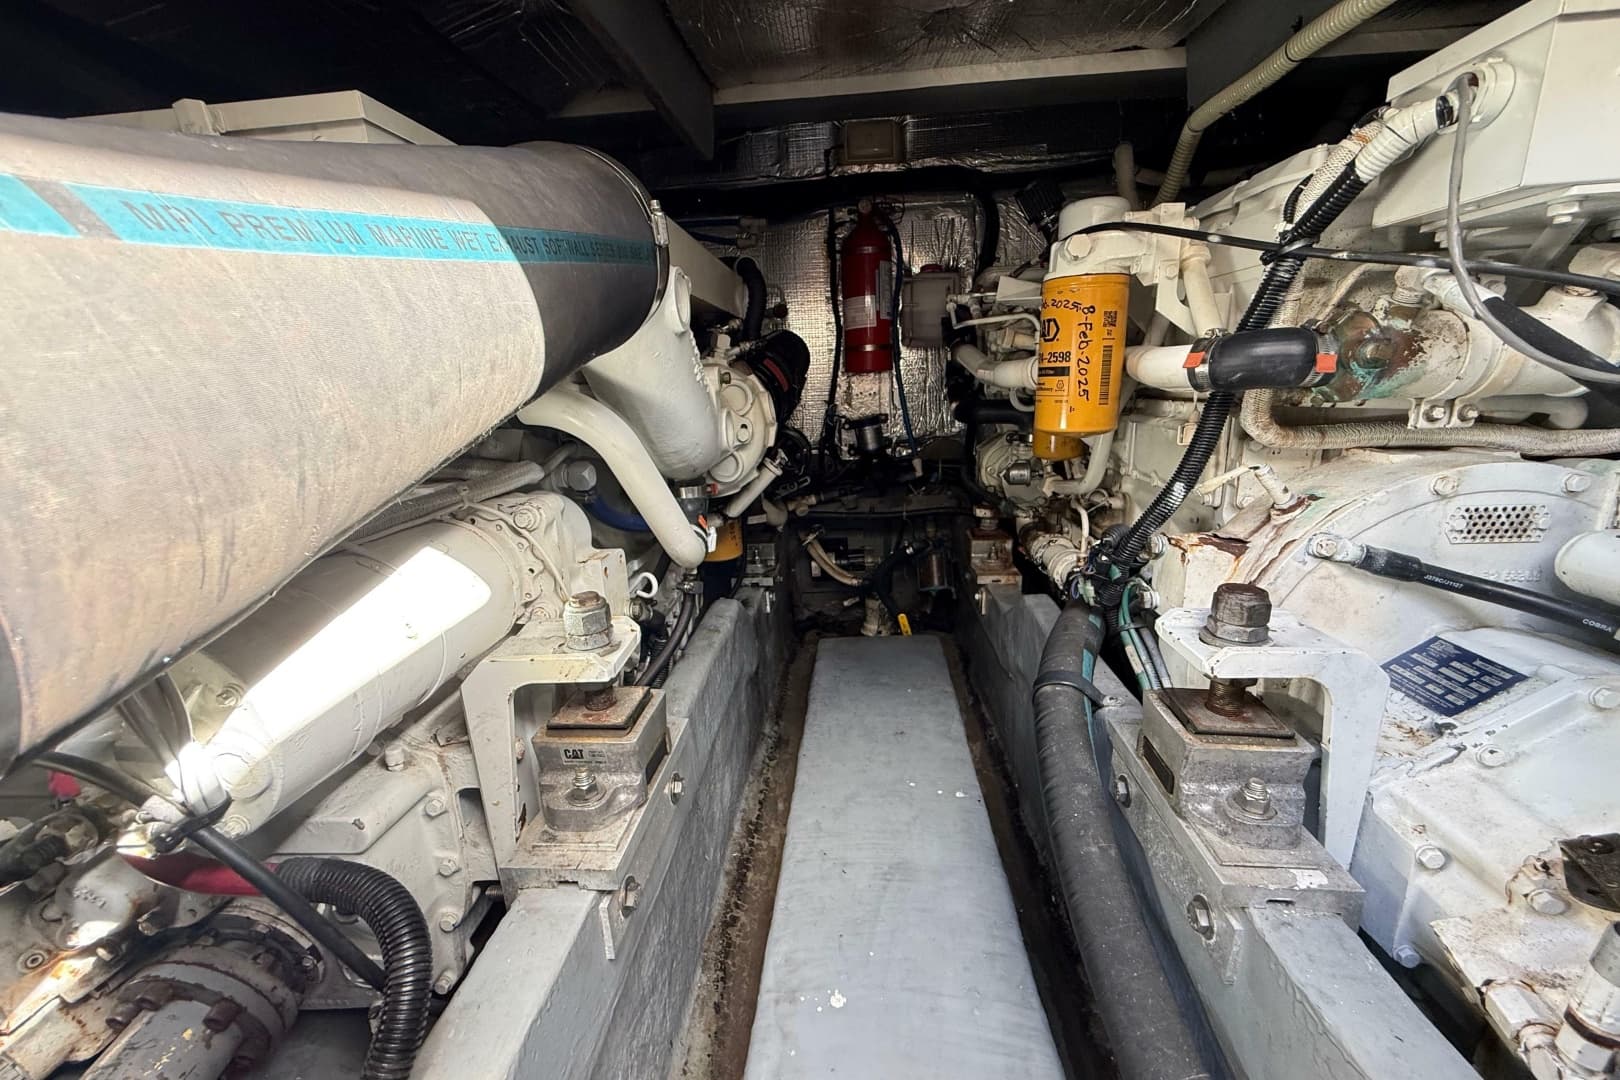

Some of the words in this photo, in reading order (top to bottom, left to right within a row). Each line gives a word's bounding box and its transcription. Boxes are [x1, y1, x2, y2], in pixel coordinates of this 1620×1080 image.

[122, 200, 217, 235] MPI
[218, 210, 368, 246] PREMIUM
[368, 223, 449, 250] MARINE
[446, 229, 484, 252] WET
[1582, 618, 1612, 633] COBRA
[563, 748, 584, 759] CAT
